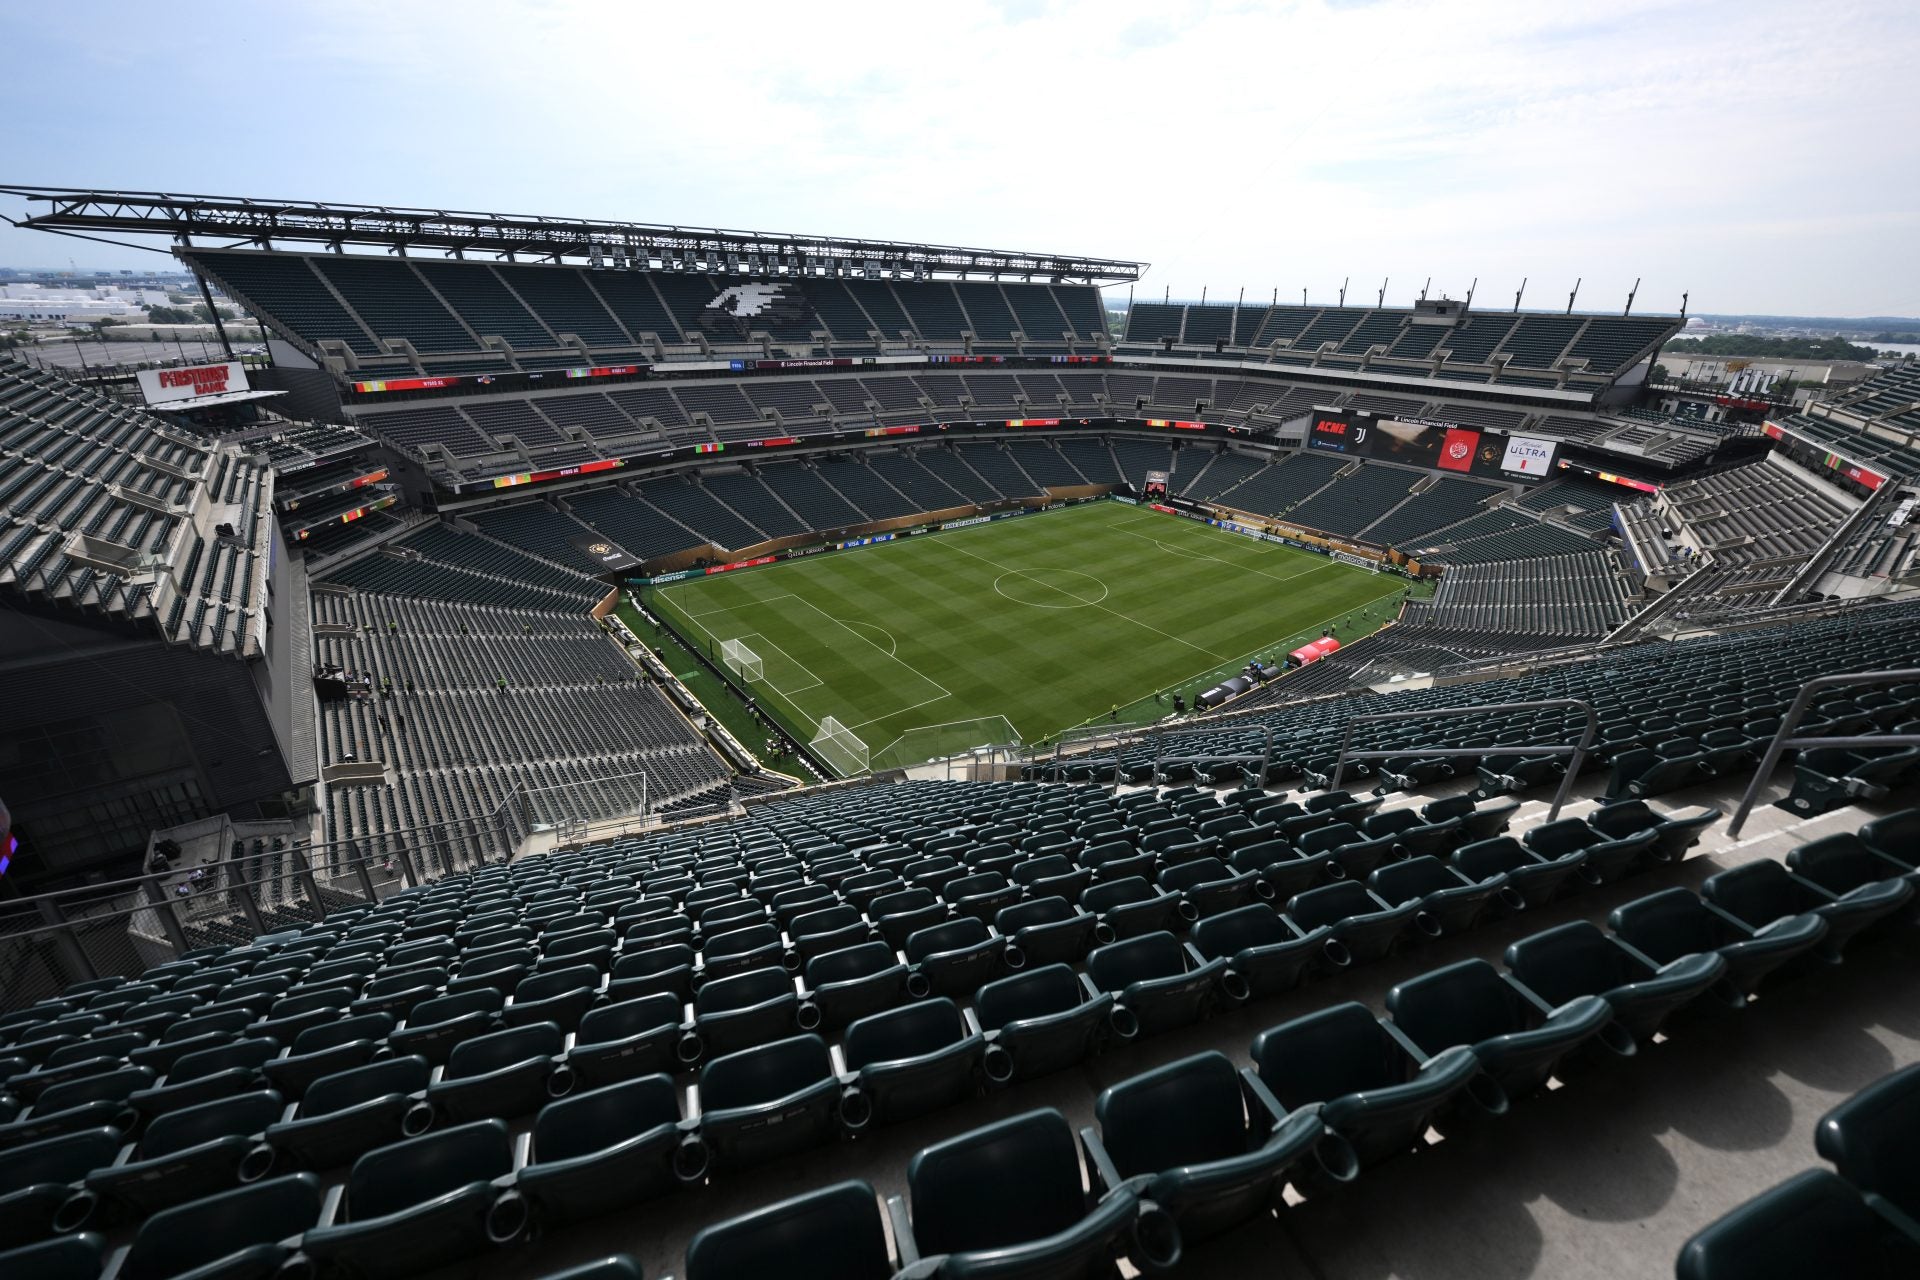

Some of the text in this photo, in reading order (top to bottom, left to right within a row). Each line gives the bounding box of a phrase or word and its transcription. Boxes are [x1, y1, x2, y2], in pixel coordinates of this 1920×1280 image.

[194, 382, 228, 395] BANK
[1726, 367, 1783, 398] Lite
[1316, 421, 1348, 435] ACME
[1419, 419, 1444, 428] Financial
[1510, 446, 1546, 458] ULTRA
[787, 550, 804, 558] QATAR
[1338, 554, 1368, 567] motorola
[649, 573, 686, 585] Hisense
